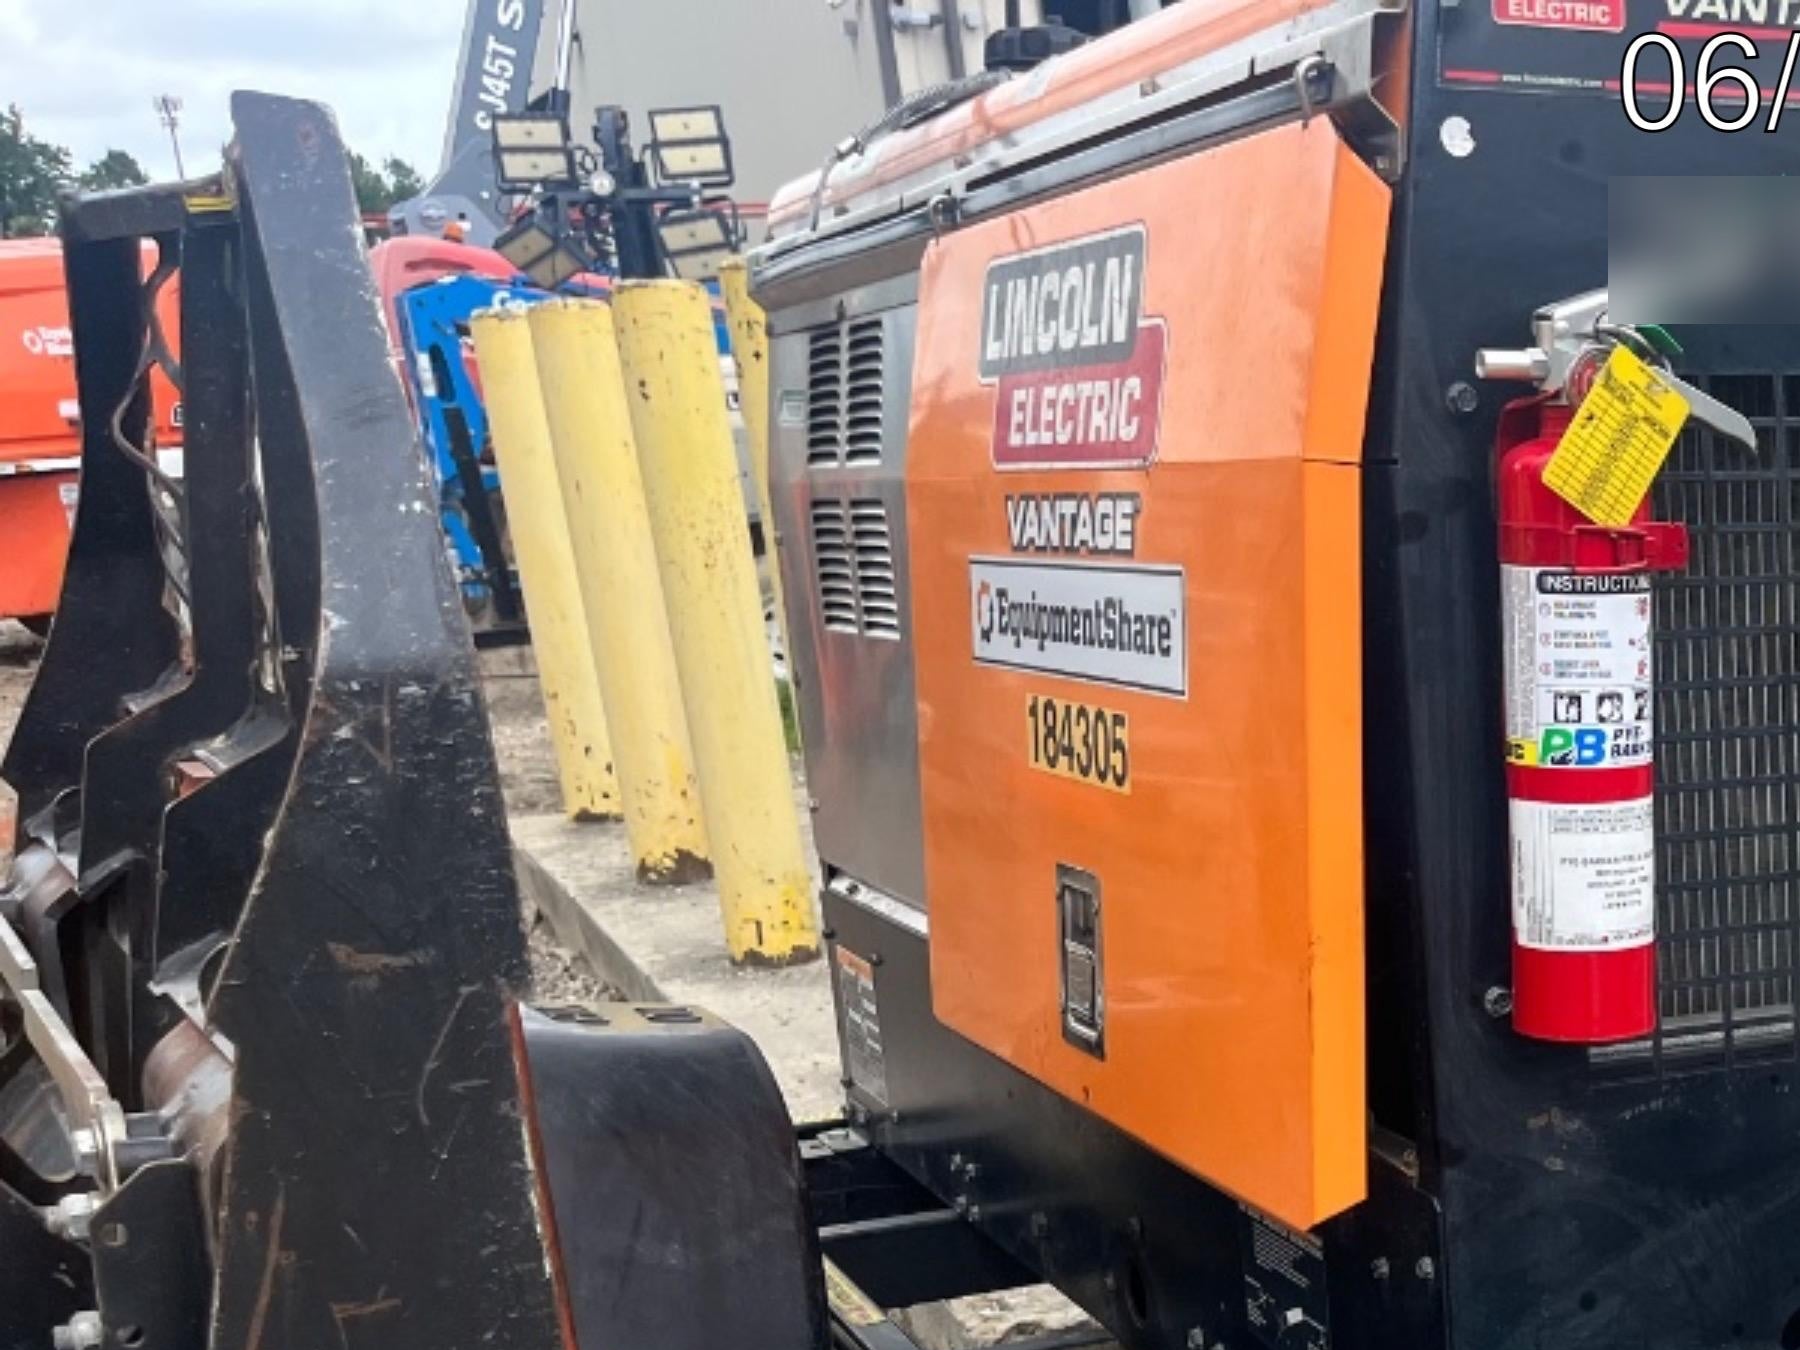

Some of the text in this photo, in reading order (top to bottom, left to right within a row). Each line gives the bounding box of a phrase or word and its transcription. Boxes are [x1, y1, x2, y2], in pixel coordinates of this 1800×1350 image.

[1507, 0, 1612, 24] ELECTRIC
[986, 254, 1134, 361] LINCOLN
[1009, 376, 1142, 446] ELECTRIC
[1007, 497, 1134, 551] VANTAGE
[995, 588, 1172, 657] EquipmentShare
[1028, 696, 1127, 787] 184305
[1541, 728, 1607, 766] PB
